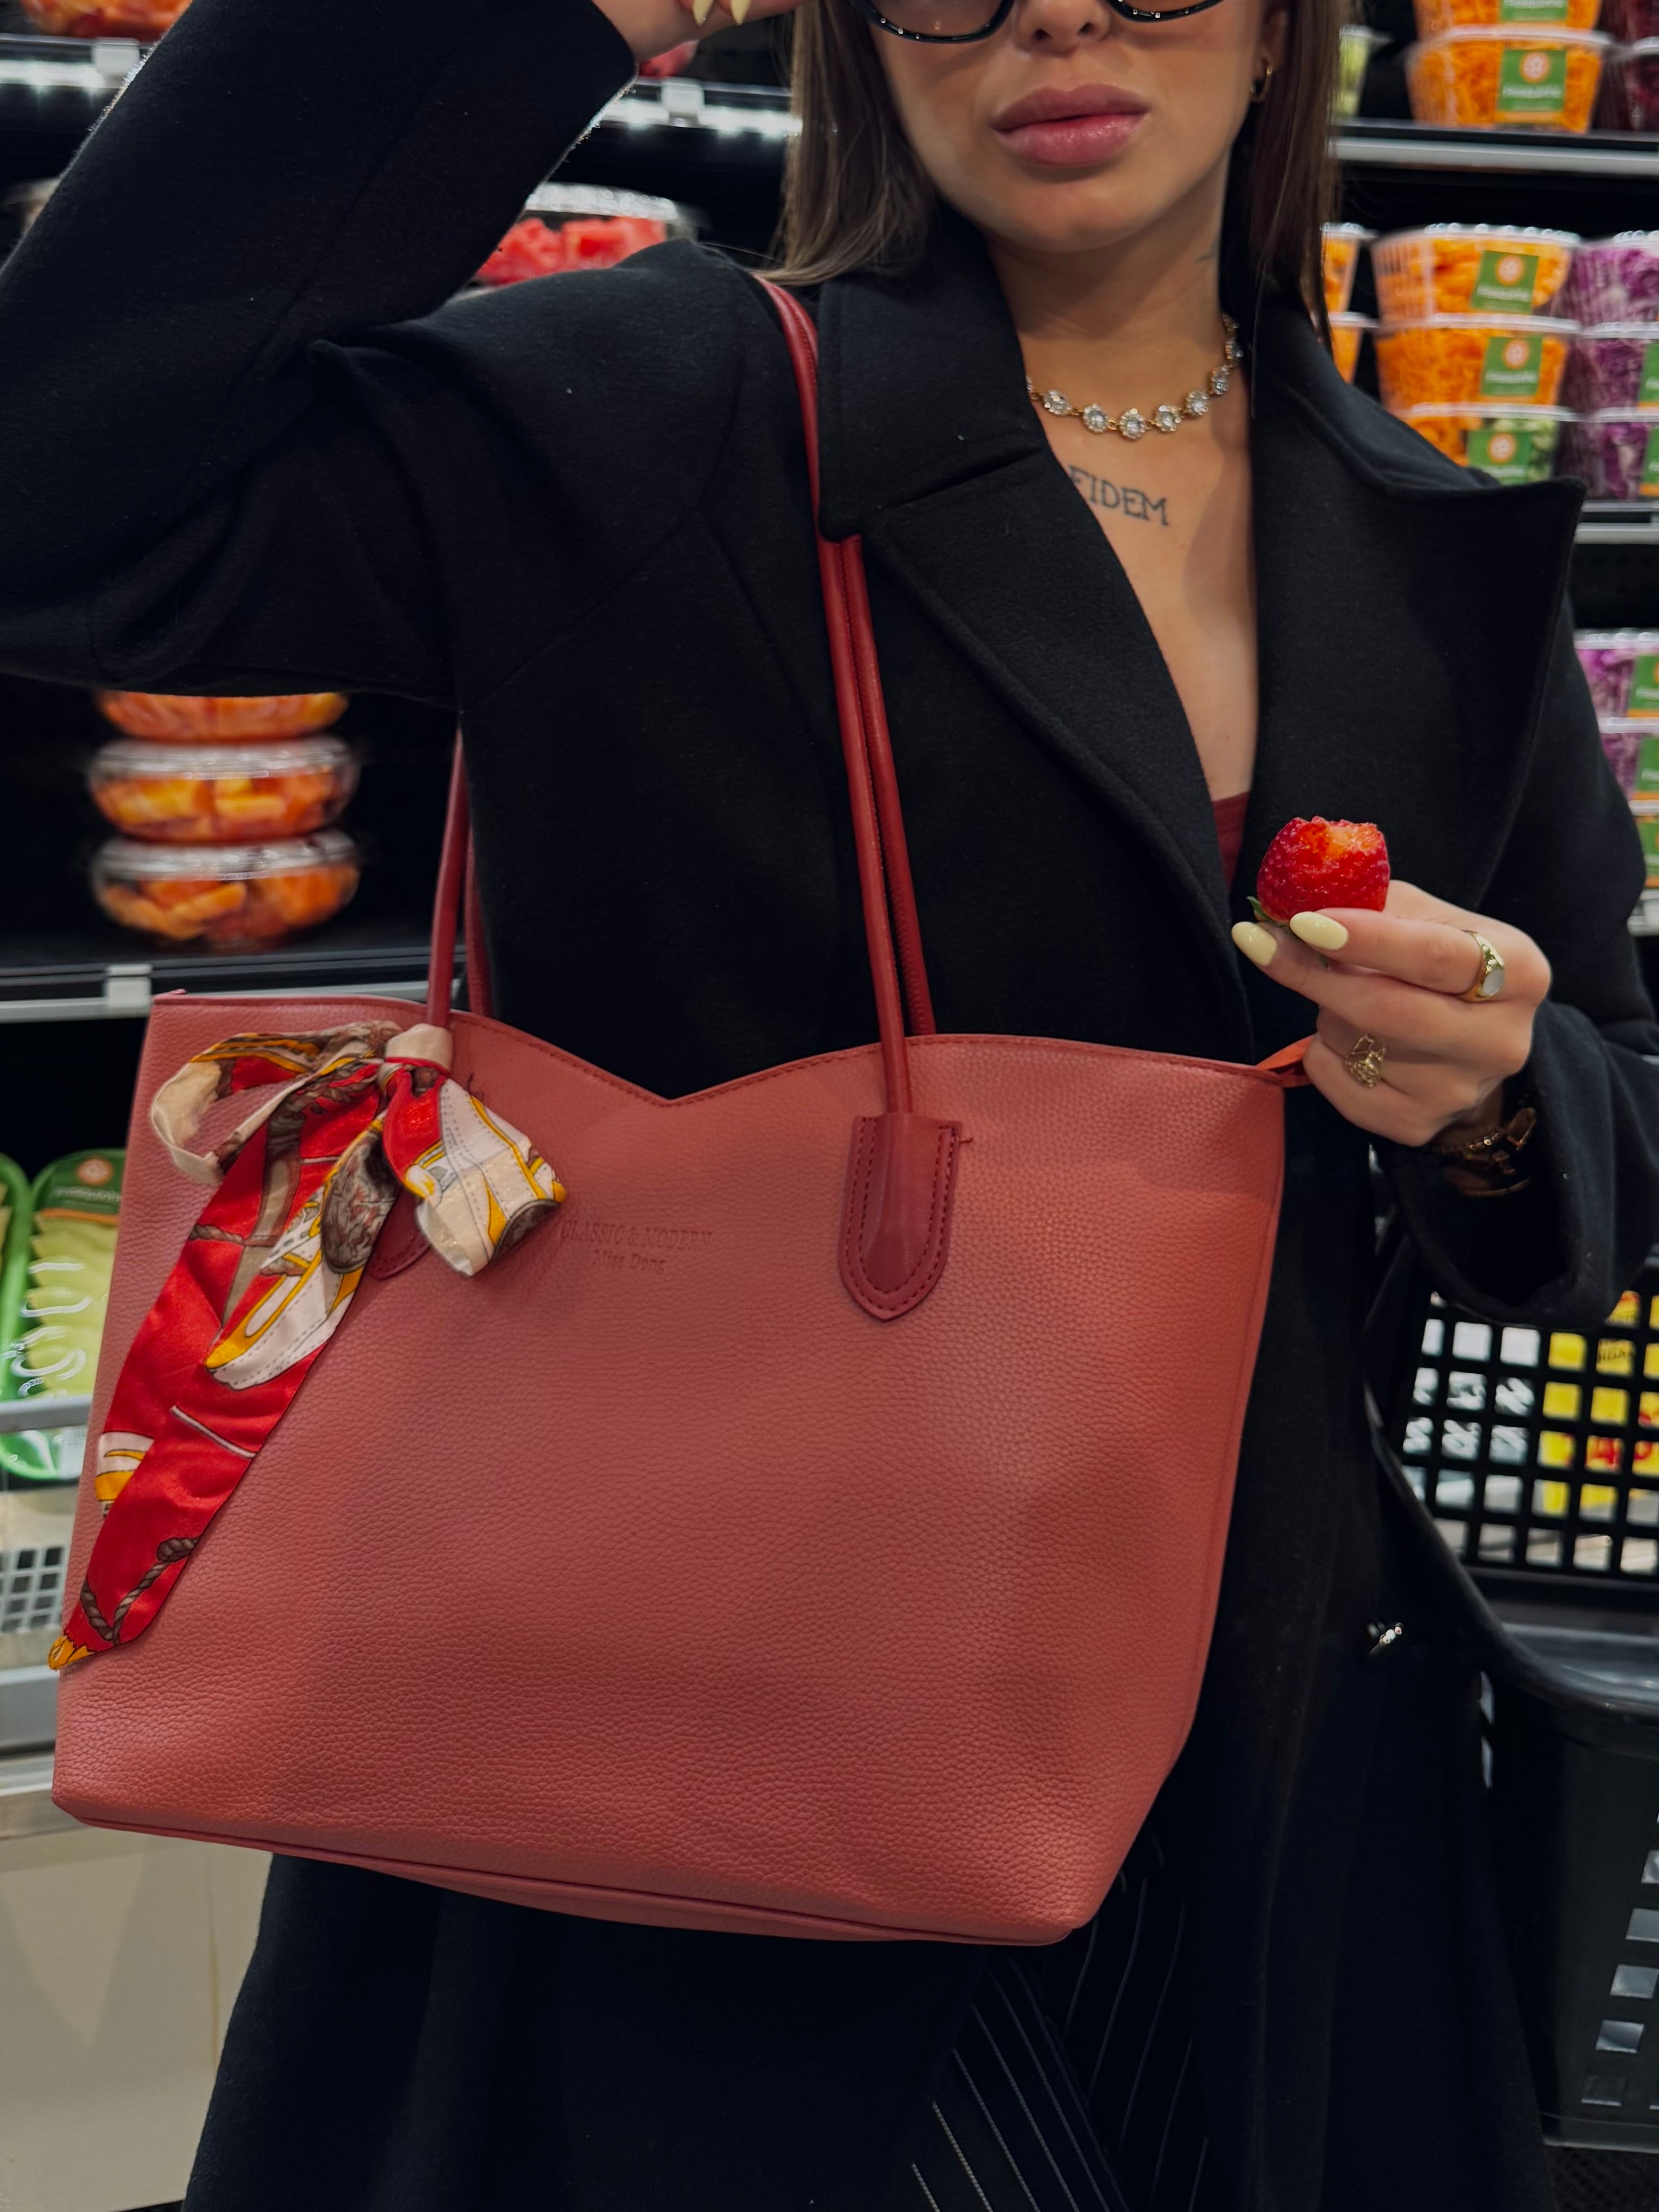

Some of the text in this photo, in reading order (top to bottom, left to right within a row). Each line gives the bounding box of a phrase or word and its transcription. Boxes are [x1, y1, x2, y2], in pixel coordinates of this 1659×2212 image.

[1068, 464, 1169, 526] FIDEM
[560, 1220, 625, 1245] CLASSIC
[628, 1226, 641, 1247] &
